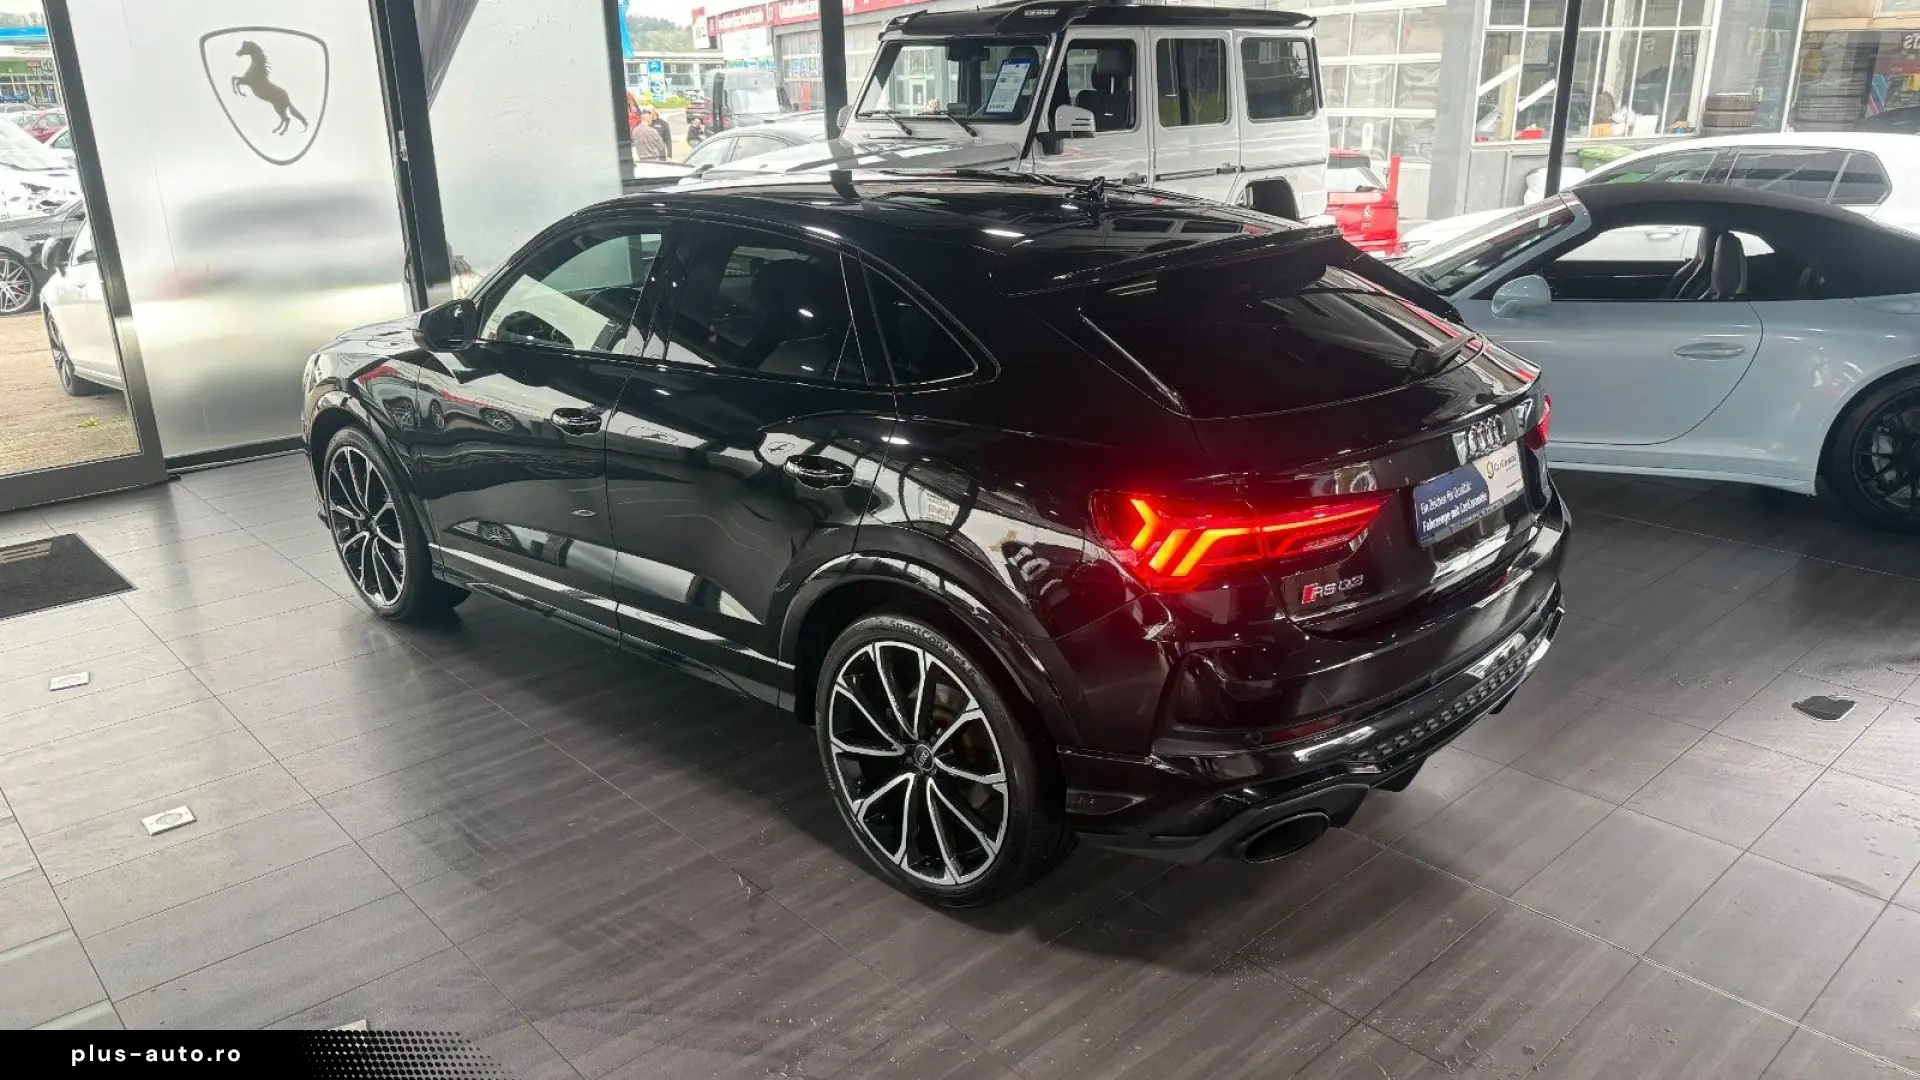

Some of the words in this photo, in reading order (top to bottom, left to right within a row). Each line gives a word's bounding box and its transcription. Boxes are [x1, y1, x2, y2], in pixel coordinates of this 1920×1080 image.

[1422, 513, 1451, 533] Fahrzeuge
[1451, 505, 1460, 519] mit
[1306, 582, 1337, 602] RS
[1338, 574, 1364, 592] Q3
